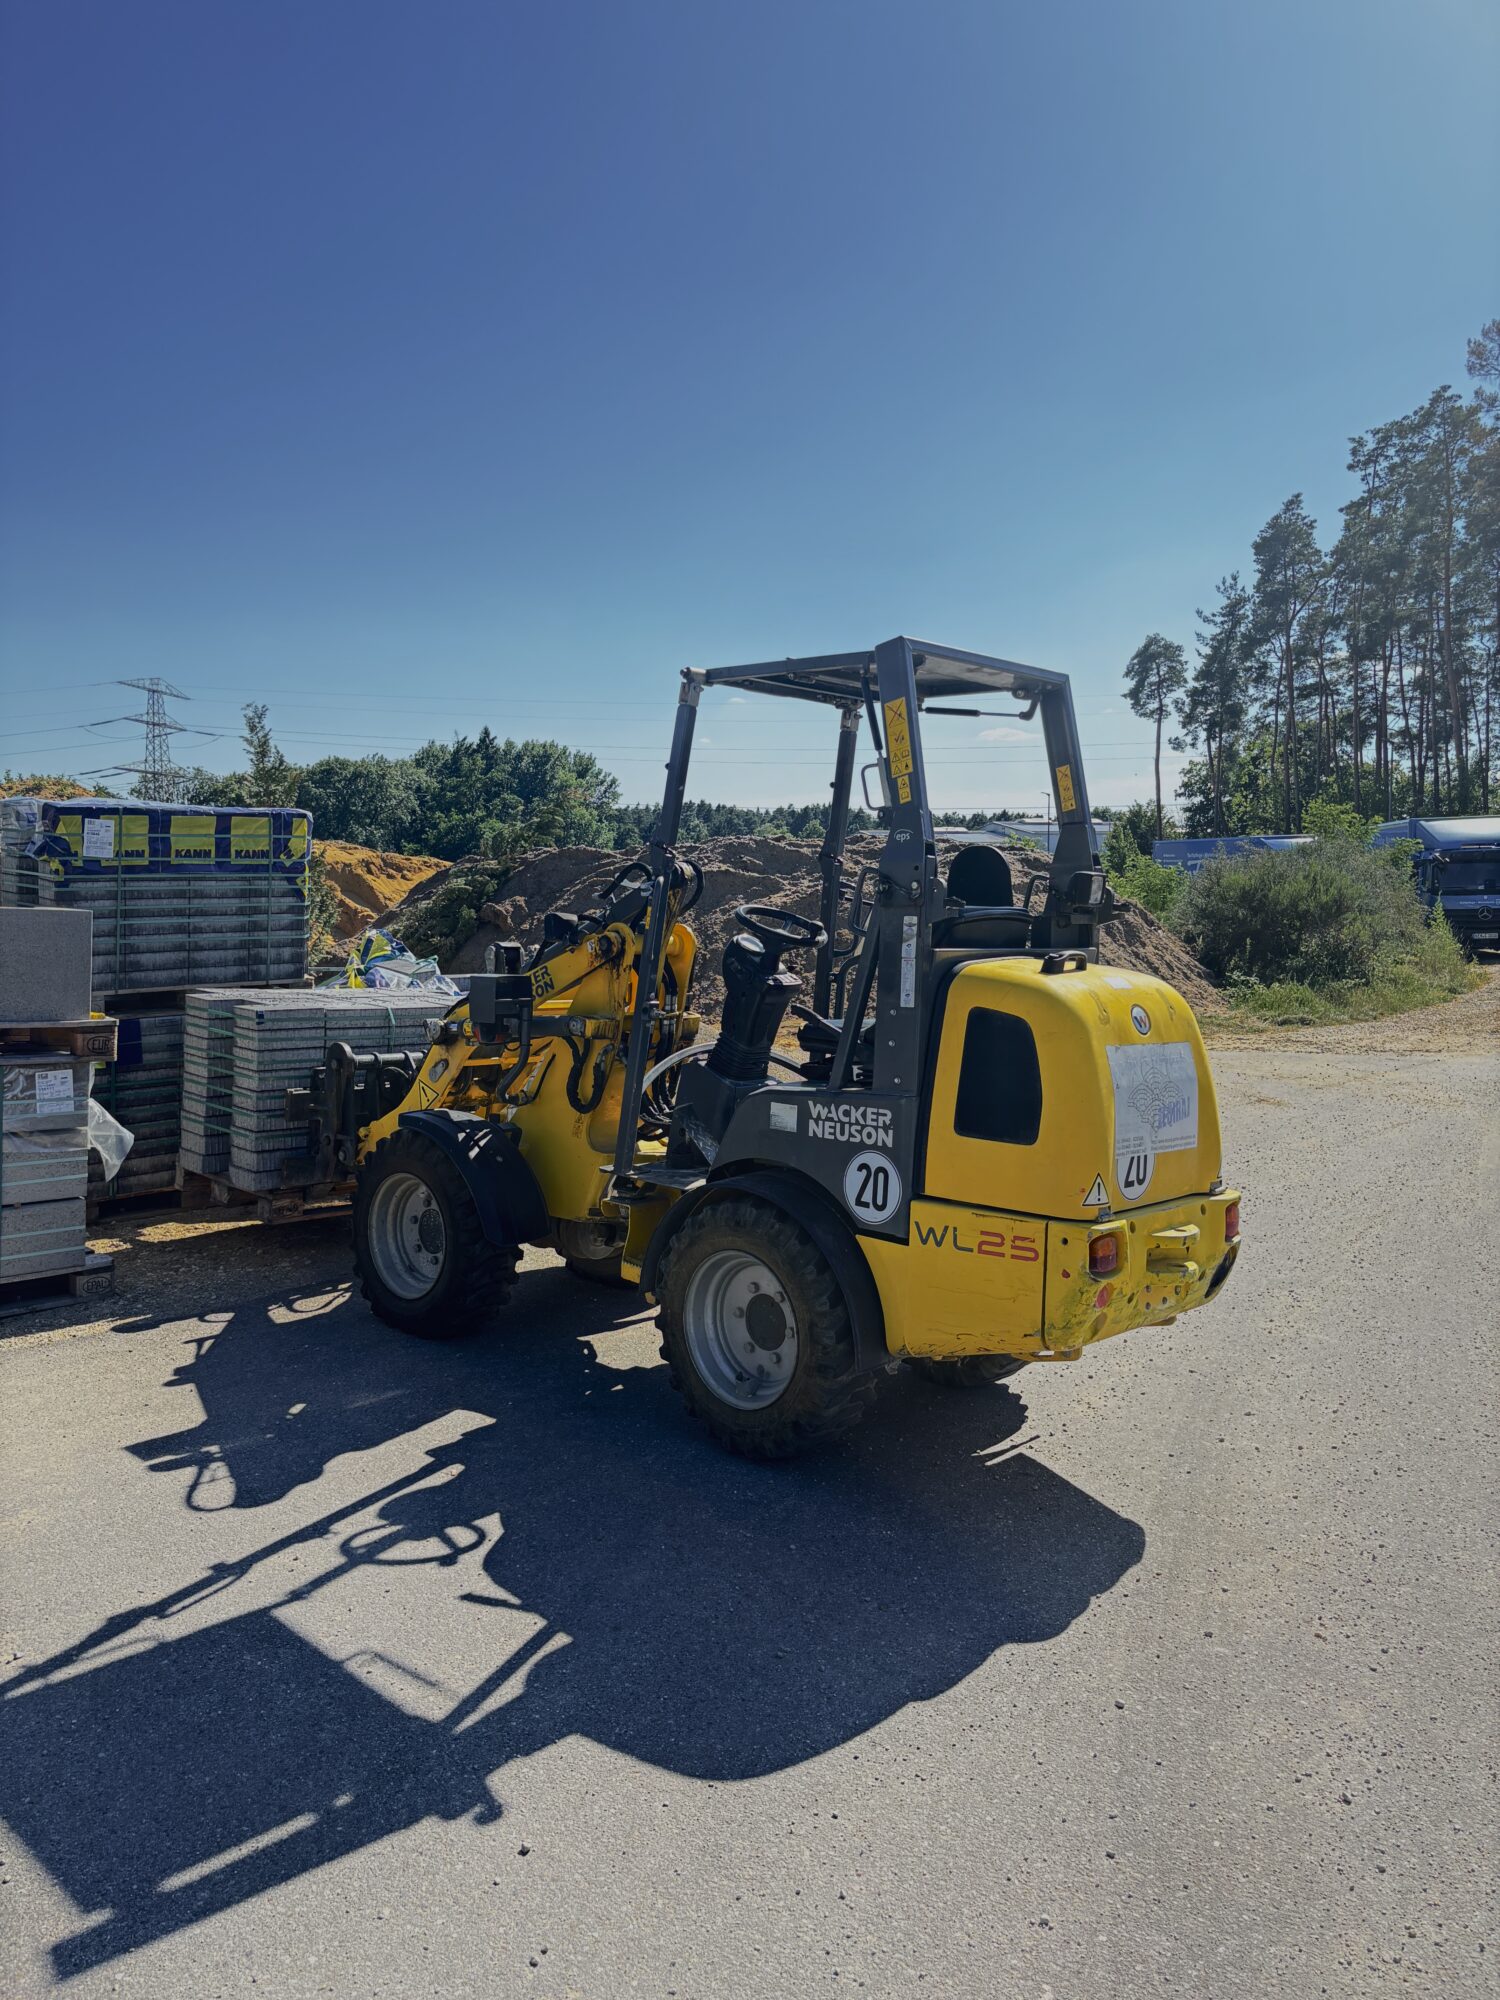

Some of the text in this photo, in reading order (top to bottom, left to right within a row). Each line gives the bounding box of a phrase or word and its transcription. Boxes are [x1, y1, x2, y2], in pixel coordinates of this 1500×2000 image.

[895, 832, 911, 843] eps
[112, 849, 146, 858] ANN
[174, 848, 212, 858] KANN
[234, 849, 271, 859] KANN
[92, 1039, 110, 1050] EUR
[807, 1100, 892, 1127] WACKER
[808, 1119, 893, 1148] NEUSON
[854, 1162, 889, 1212] 20
[914, 1220, 1040, 1262] WL25
